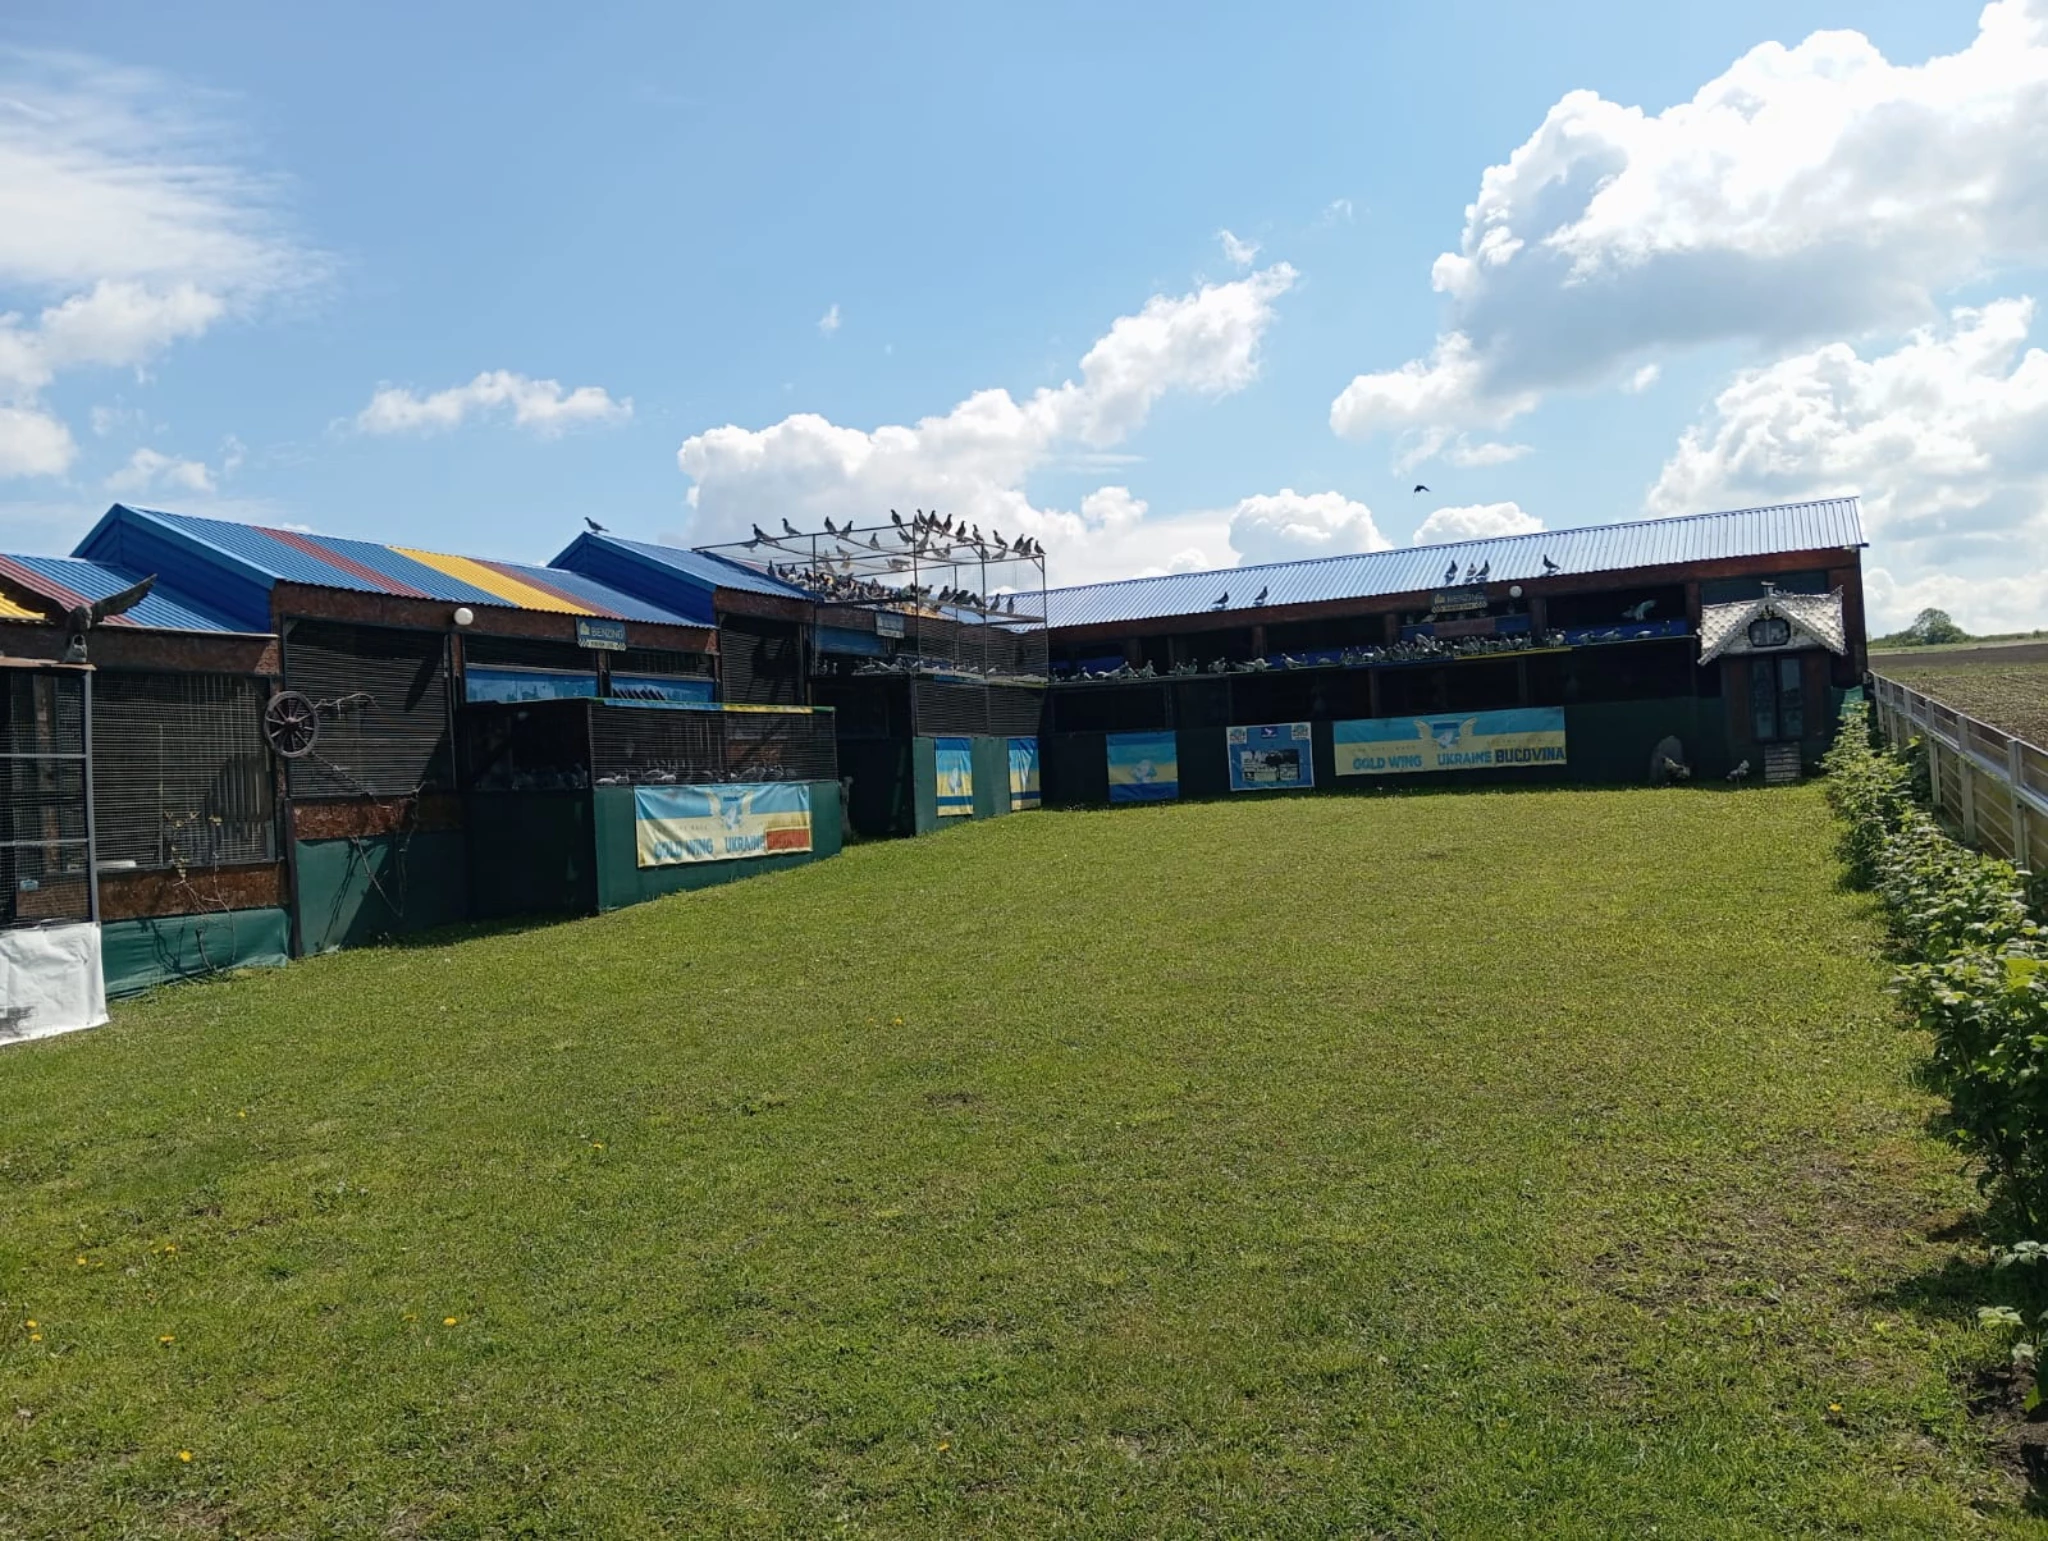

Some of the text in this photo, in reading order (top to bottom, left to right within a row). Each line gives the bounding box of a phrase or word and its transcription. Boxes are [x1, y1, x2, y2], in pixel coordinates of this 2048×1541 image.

[1353, 747, 1566, 770] GOLD WING UKRAINE BUCOVINA
[686, 838, 713, 856] WING
[725, 834, 765, 852] UKRAINE
